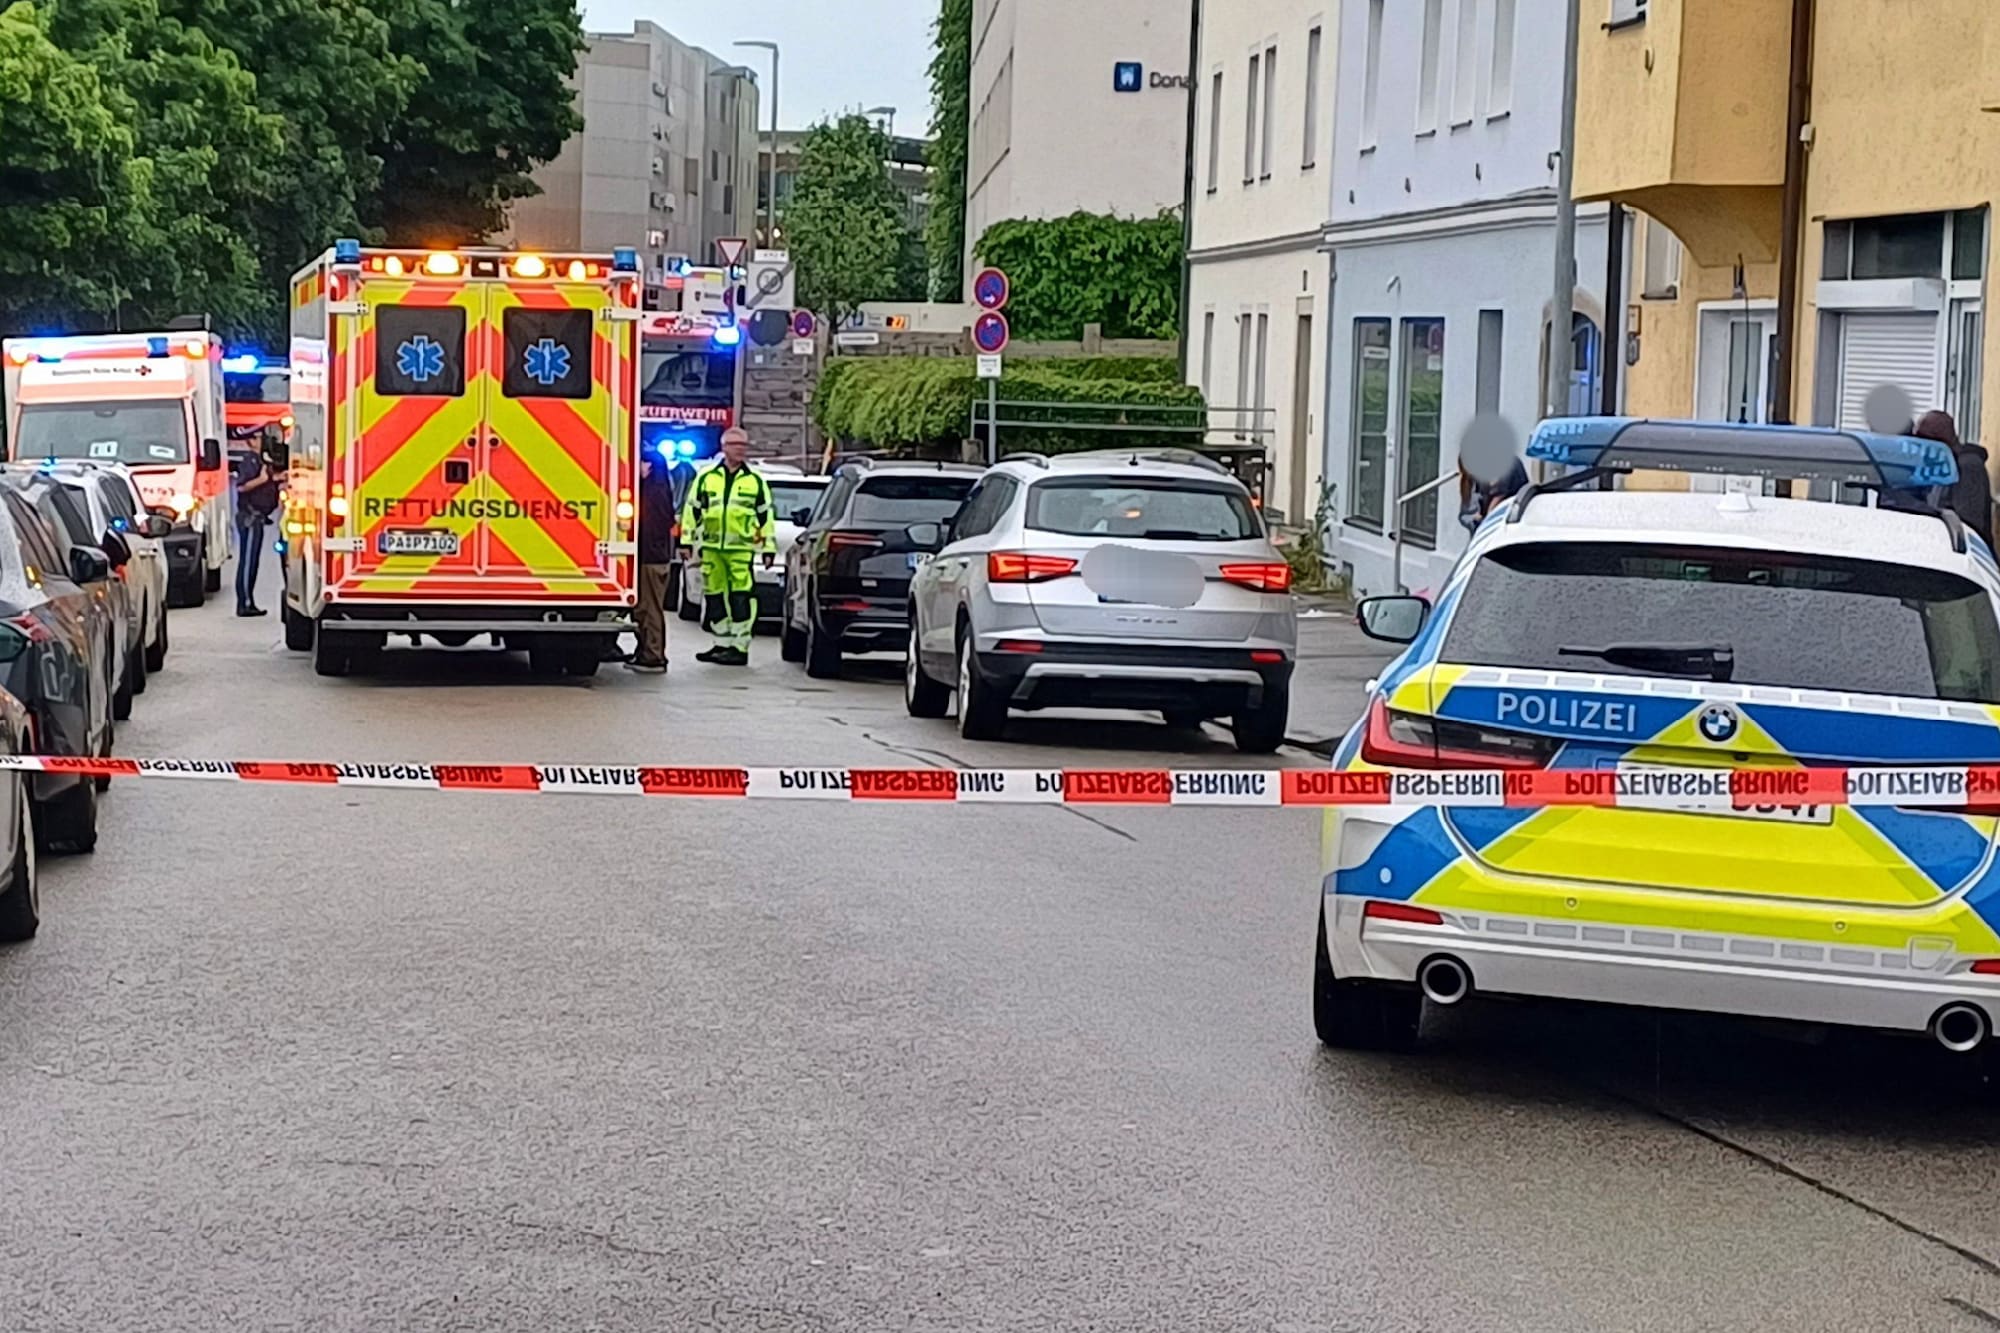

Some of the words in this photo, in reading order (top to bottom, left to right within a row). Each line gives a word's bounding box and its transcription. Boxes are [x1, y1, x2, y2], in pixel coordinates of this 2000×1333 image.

[365, 498, 597, 520] RETTUNGSDIENST
[388, 536, 404, 548] PA
[1497, 692, 1636, 732] POLIZEI
